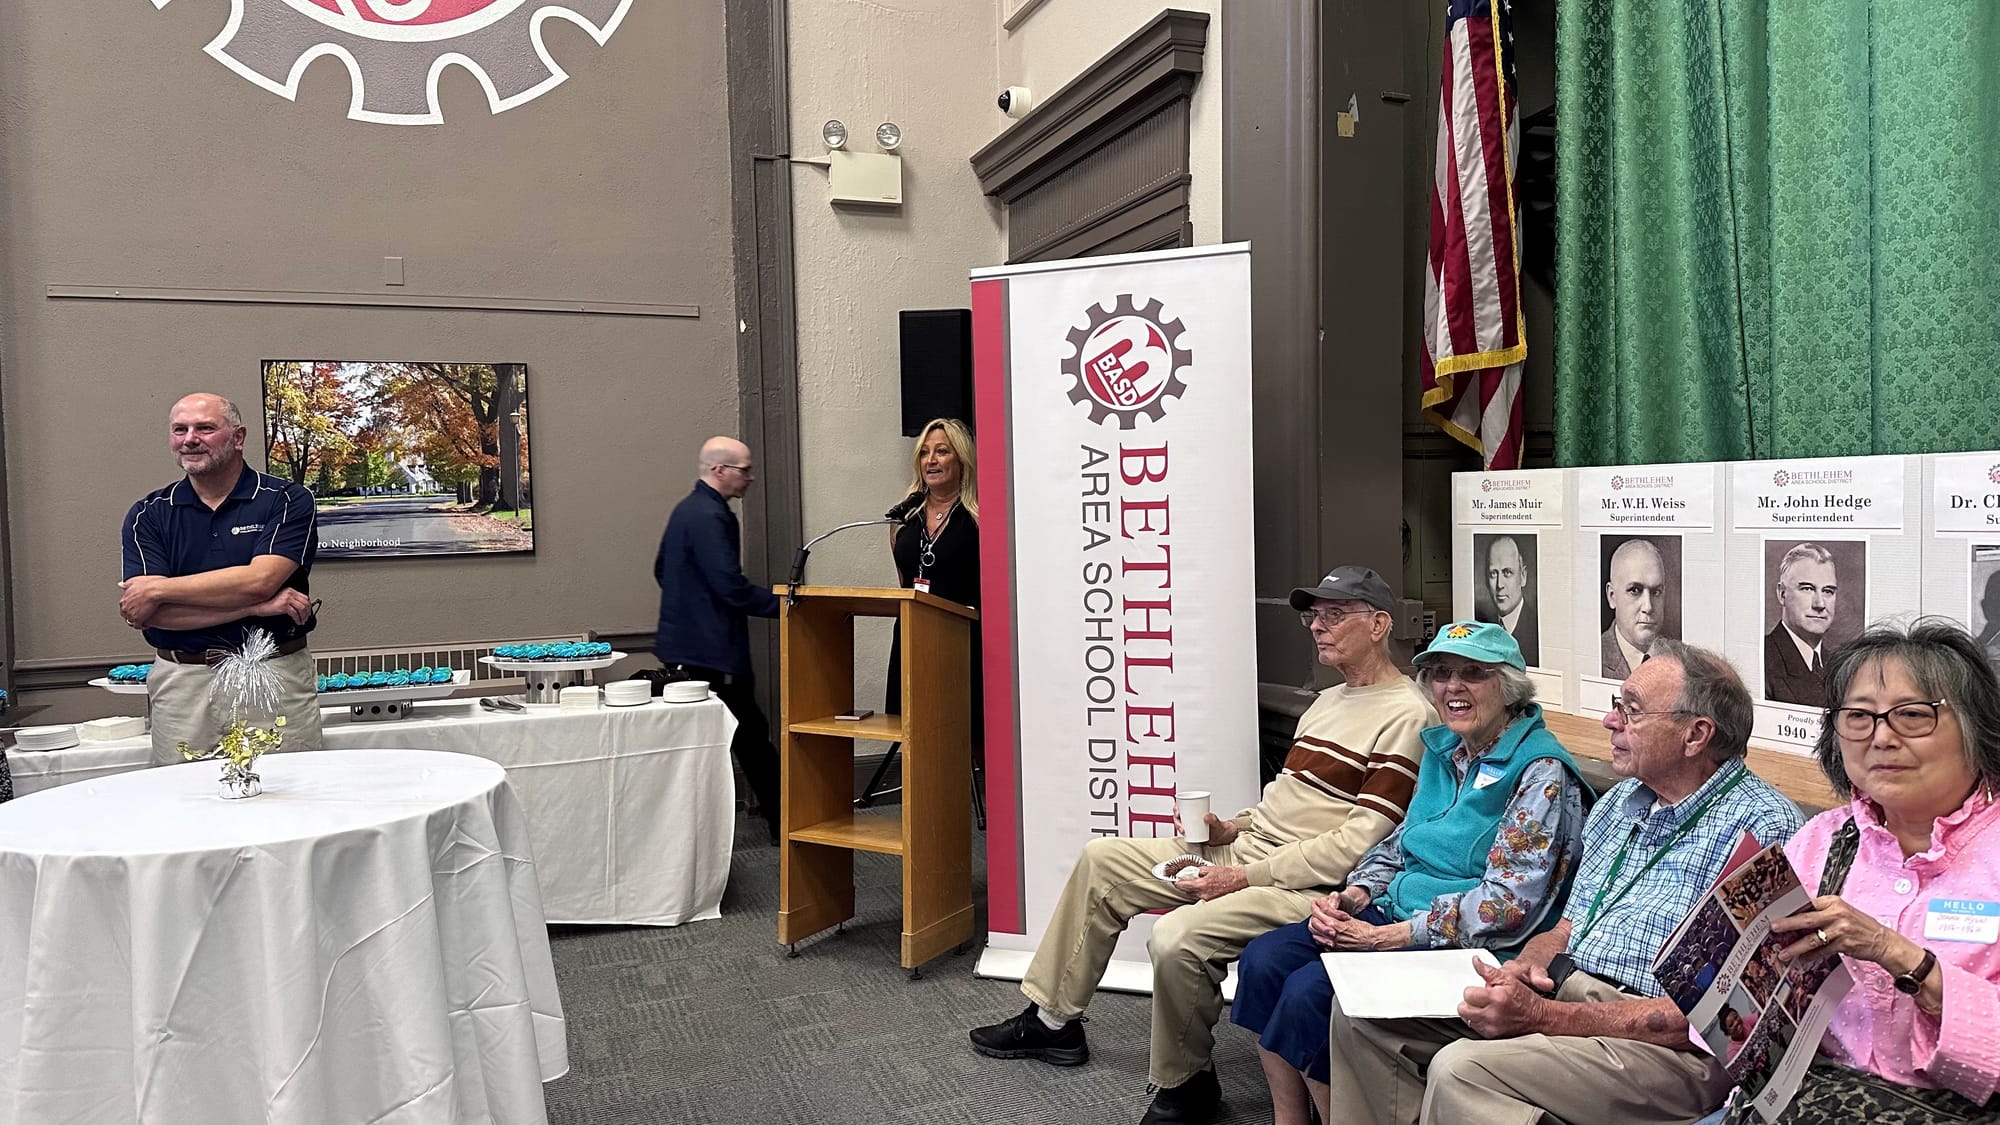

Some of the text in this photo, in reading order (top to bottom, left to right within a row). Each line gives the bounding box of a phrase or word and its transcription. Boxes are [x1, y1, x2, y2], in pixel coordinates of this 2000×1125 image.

[1097, 352, 1138, 405] BASD
[1625, 476, 1673, 484] BETHLEHEM
[1791, 470, 1852, 480] BETHLEHEM
[1081, 444, 1111, 551] AREA
[1601, 497, 1686, 509] Mr. W.H. Weiss
[1757, 494, 1872, 510] Mr. John Hedge
[1950, 495, 1977, 509] Dr.
[1472, 498, 1543, 509] Mr. James Muir
[1480, 513, 1532, 521] Superintendent
[1610, 513, 1675, 523] Superintendent
[1772, 513, 1854, 524] Superintendent
[331, 538, 401, 549] Neighborhood
[1083, 562, 1116, 726] SCHOOL
[1119, 440, 1178, 838] BETHLEHE
[1787, 714, 1814, 725] Proudly
[1777, 724, 1806, 739] 1940
[1943, 901, 1985, 911] HELLO
[1727, 915, 1770, 975] BETHLEHEM
